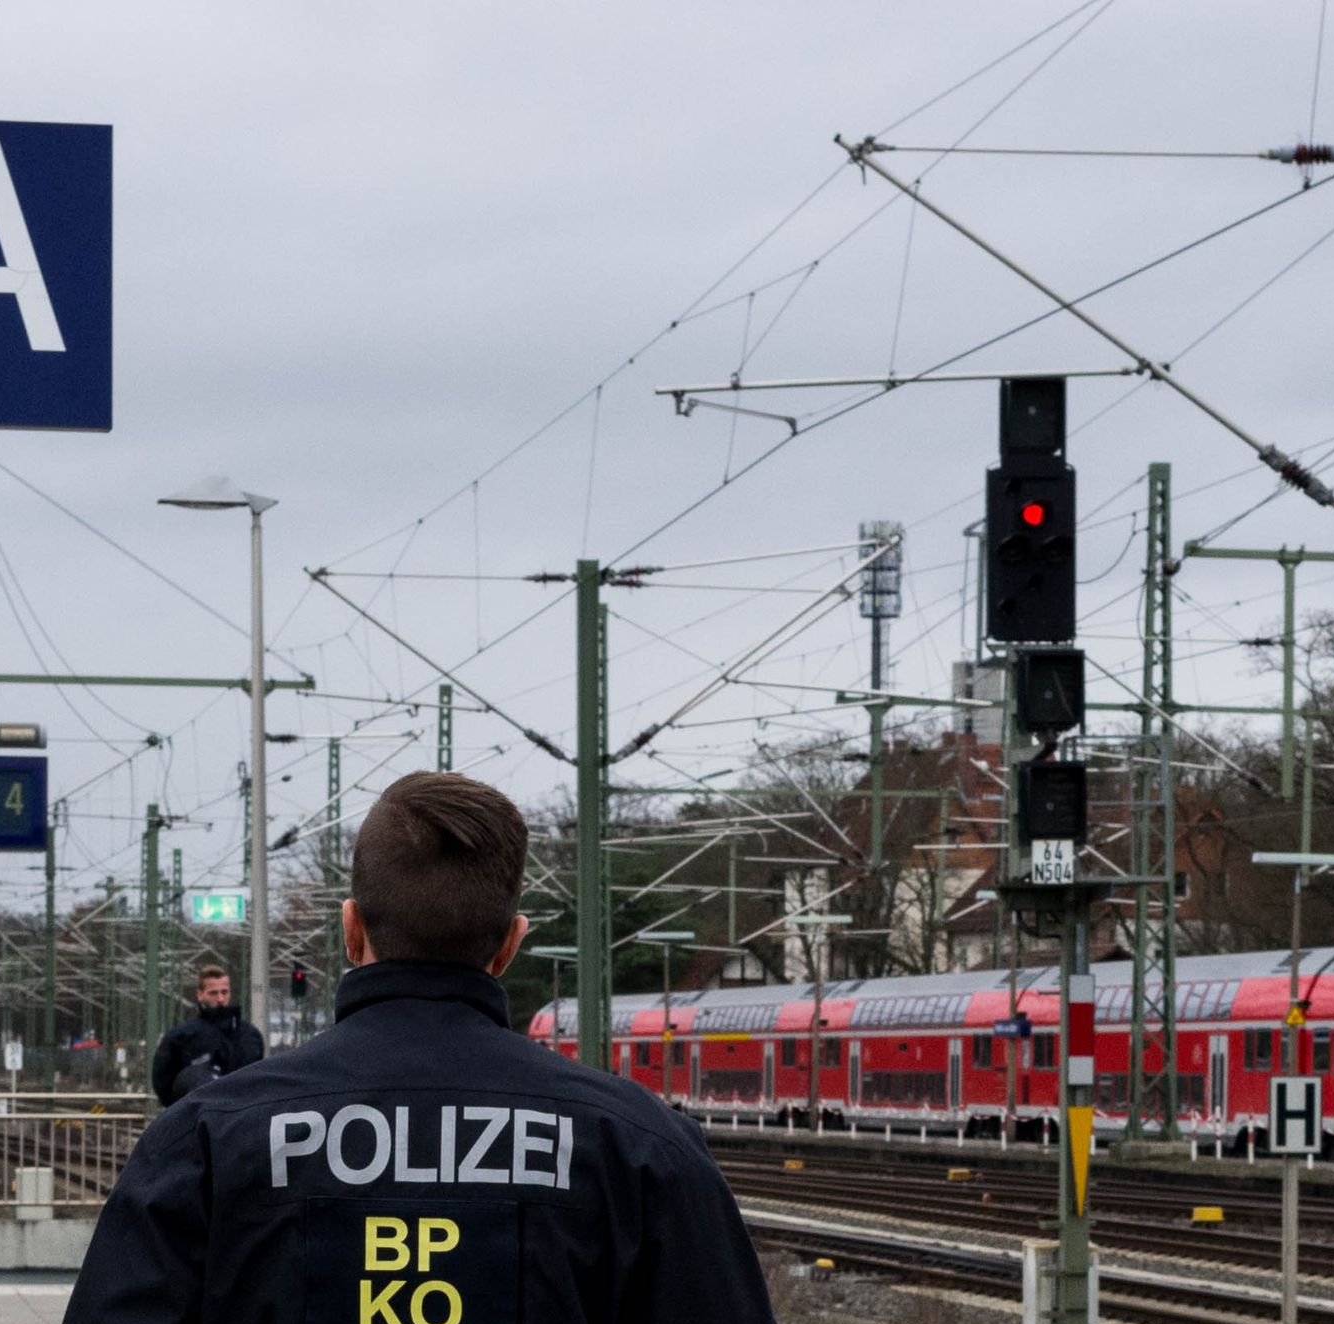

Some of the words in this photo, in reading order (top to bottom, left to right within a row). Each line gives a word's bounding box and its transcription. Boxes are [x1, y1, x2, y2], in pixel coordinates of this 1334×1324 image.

[5, 781, 24, 816] 4
[1034, 862, 1071, 880] N504
[1276, 1083, 1315, 1147] H
[270, 1104, 573, 1190] POLIZEI
[364, 1216, 460, 1272] BP
